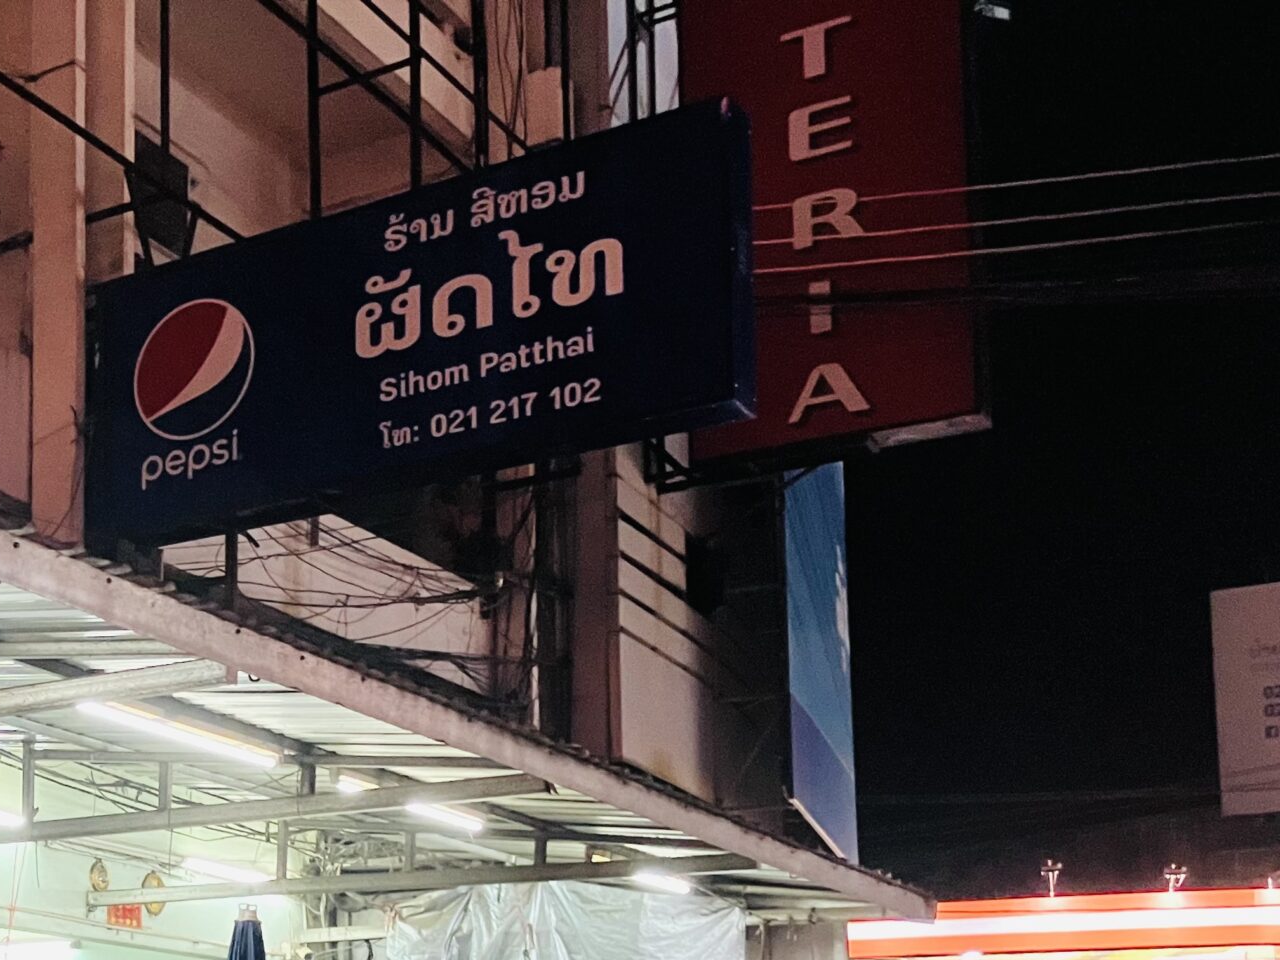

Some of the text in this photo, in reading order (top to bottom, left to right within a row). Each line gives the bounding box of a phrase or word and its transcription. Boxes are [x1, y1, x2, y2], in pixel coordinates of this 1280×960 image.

[379, 326, 594, 402] Sihom Patthai
[430, 405, 478, 438] 021
[489, 391, 538, 425] 217
[549, 377, 601, 410] 102
[141, 428, 239, 491] pepsi
